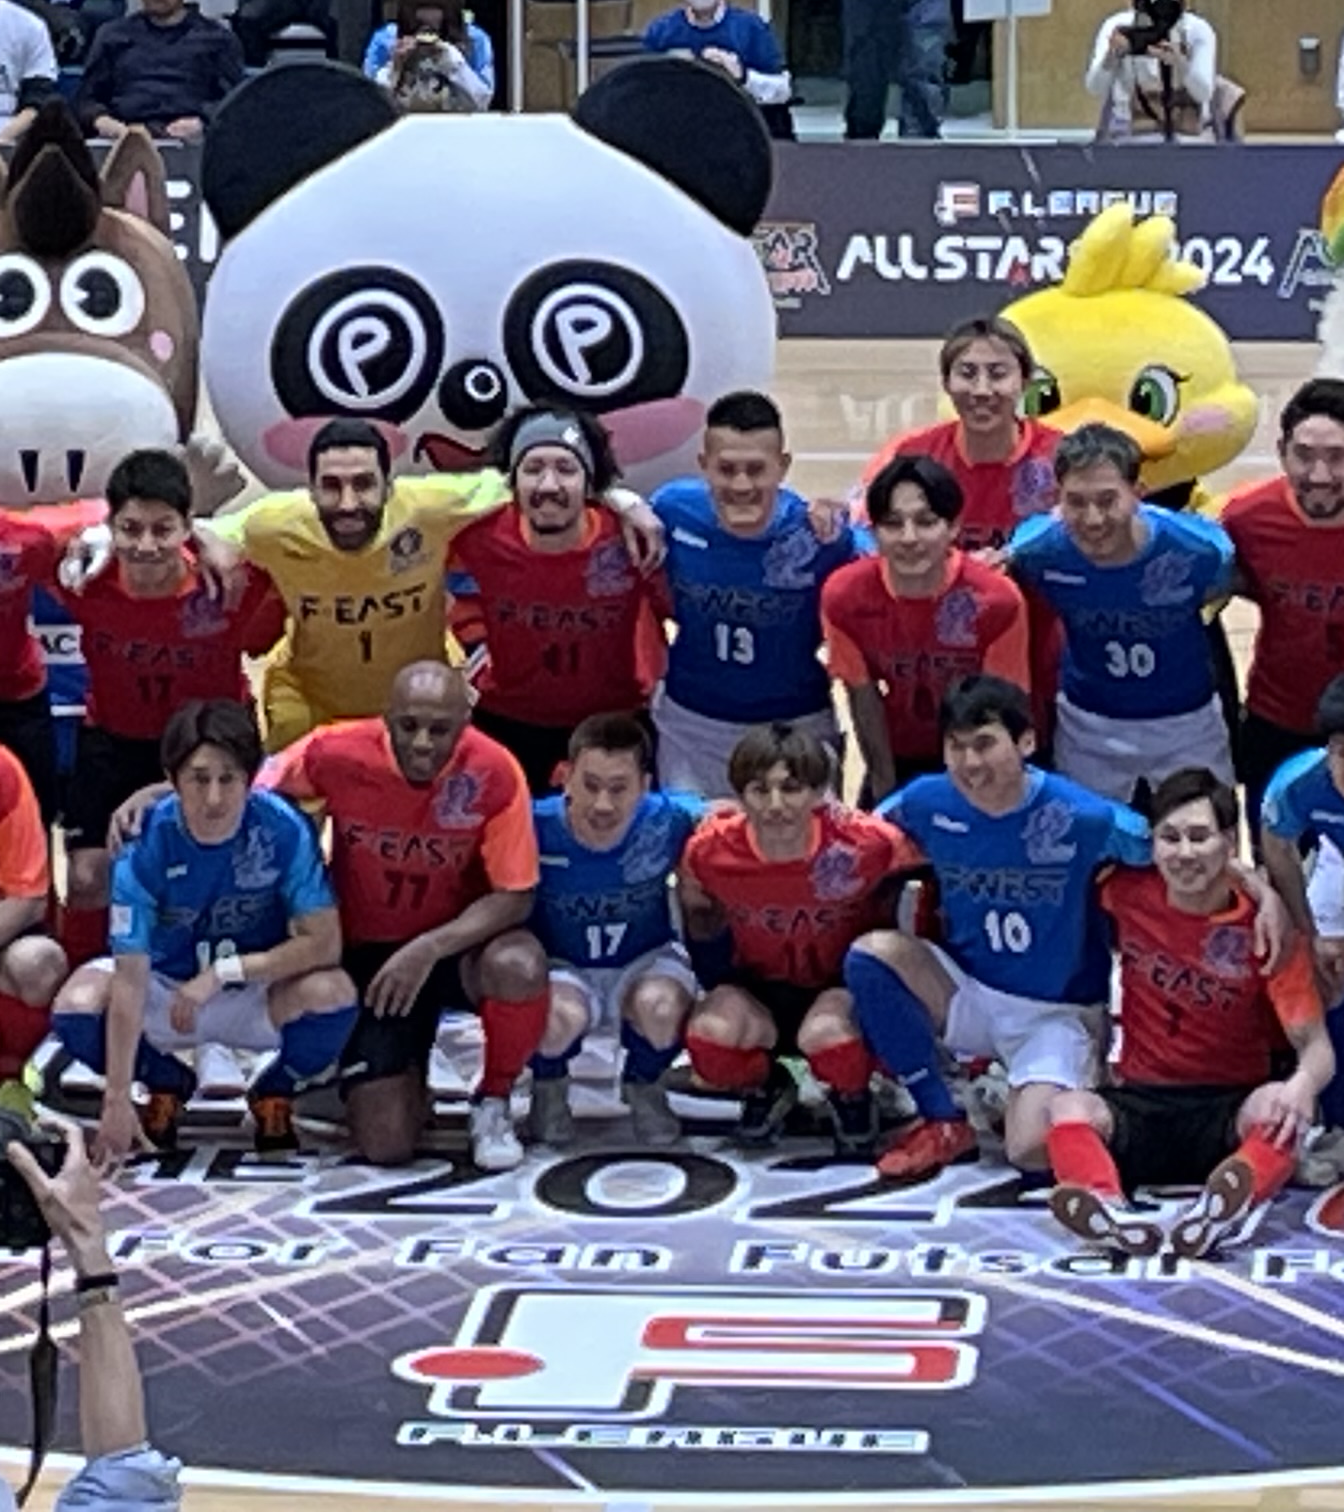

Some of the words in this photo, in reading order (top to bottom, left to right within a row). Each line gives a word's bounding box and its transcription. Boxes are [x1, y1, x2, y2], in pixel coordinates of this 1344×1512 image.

[359, 631, 372, 663] 1
[714, 622, 755, 666] 13
[1104, 641, 1155, 678] 30
[384, 870, 430, 909] 77
[586, 921, 630, 960] 17
[984, 909, 1033, 953] 10
[108, 1229, 326, 1269] For
[394, 1237, 674, 1273] Fan
